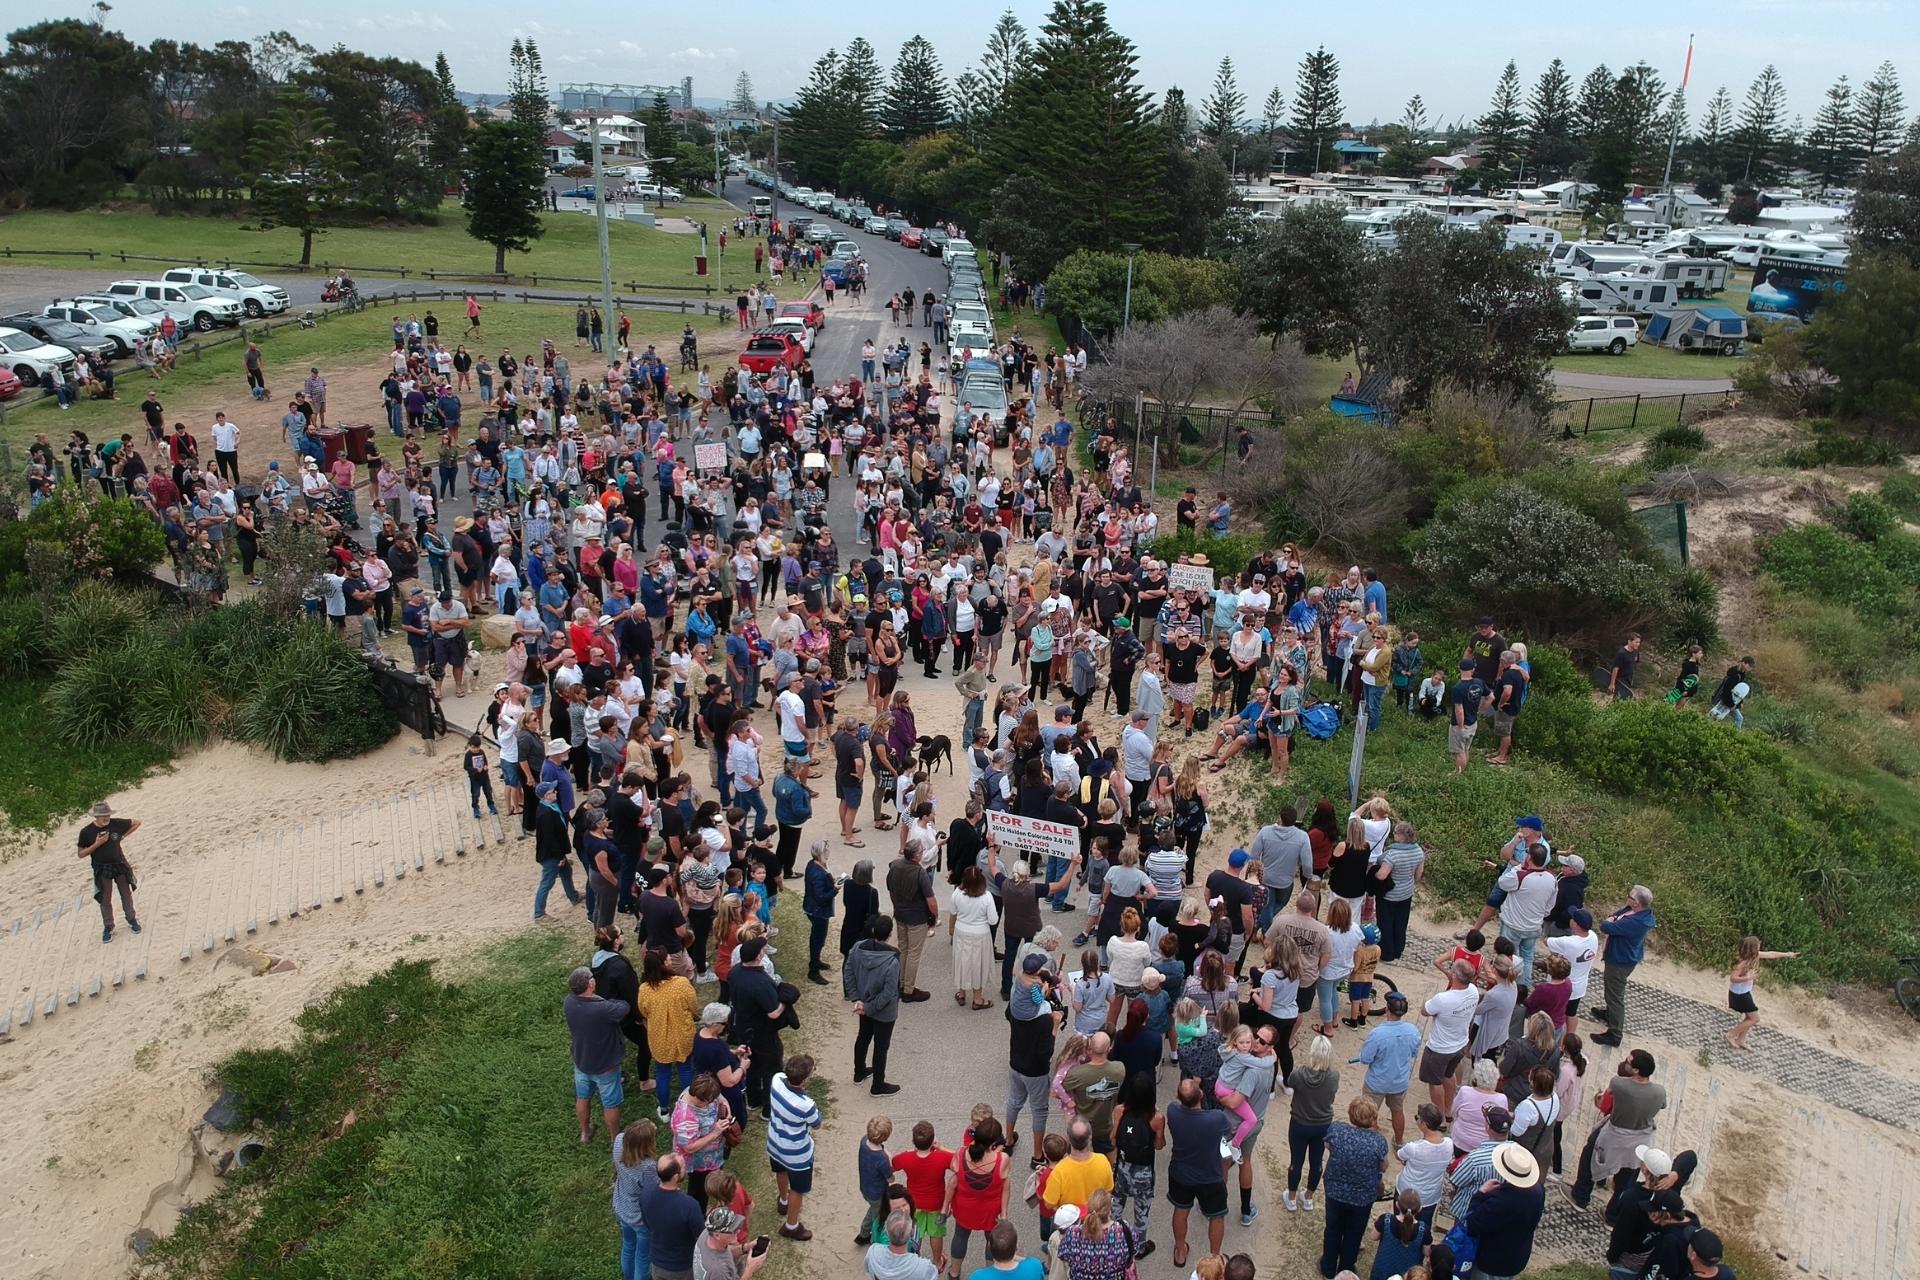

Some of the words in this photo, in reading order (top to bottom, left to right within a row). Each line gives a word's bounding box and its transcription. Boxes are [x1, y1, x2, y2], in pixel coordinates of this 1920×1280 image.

[991, 814, 1021, 827] FOR
[1032, 822, 1072, 836] SALE
[992, 825, 1006, 833] 2012
[1007, 827, 1027, 836] Holden
[1027, 831, 1053, 842] Colorado
